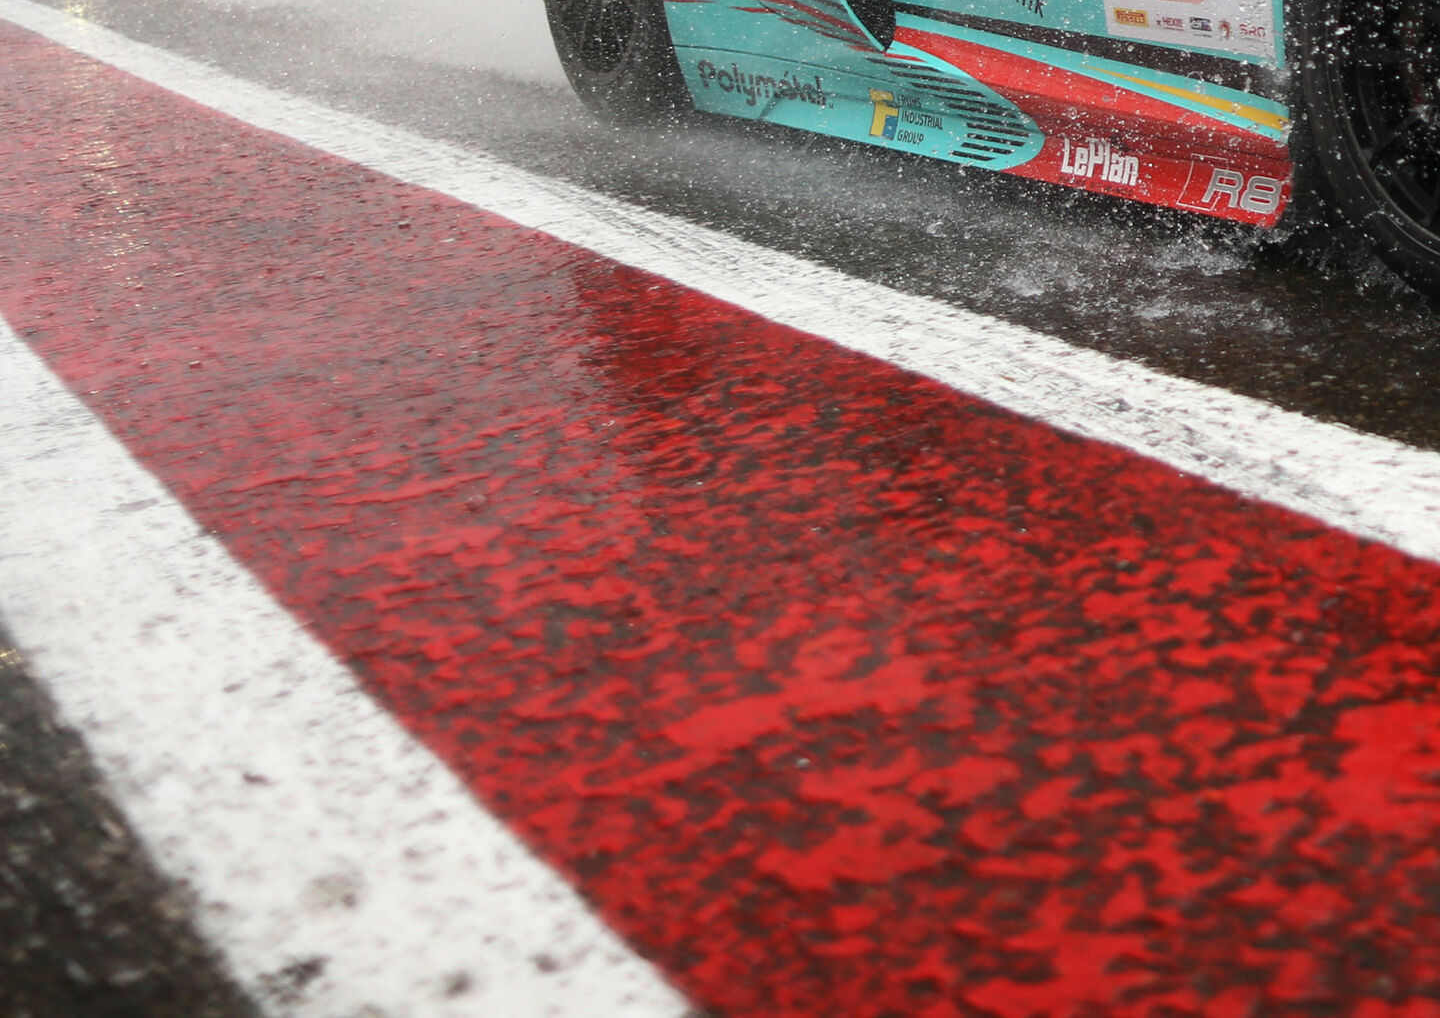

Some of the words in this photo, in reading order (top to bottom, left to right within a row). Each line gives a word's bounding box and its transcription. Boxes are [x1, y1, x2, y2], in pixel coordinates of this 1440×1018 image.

[901, 110, 943, 130] INDUSTRIAL
[897, 129, 925, 146] GROUP
[1060, 133, 1140, 186] LePlan
[1201, 168, 1283, 214] R8
